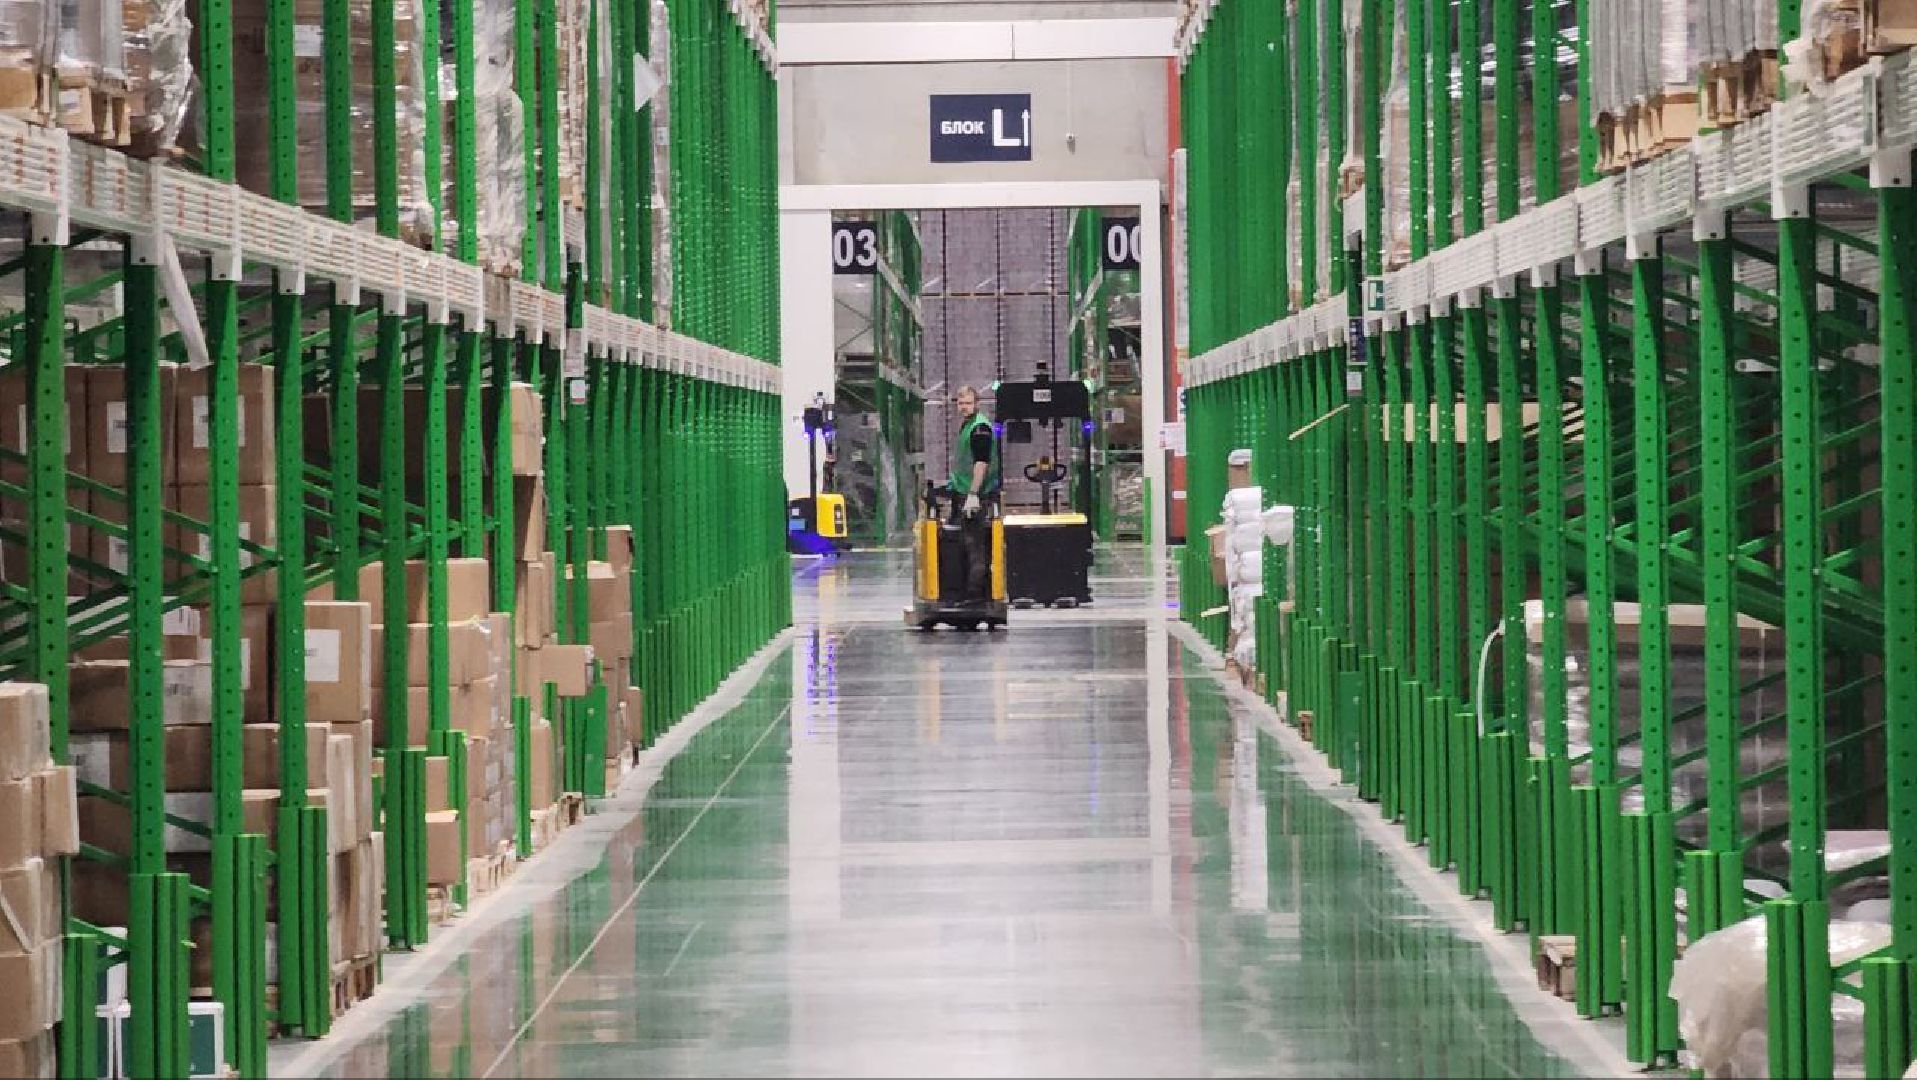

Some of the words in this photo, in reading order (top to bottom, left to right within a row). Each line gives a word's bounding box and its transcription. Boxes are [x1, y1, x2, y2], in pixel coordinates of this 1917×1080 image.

[941, 121, 984, 134] БЛОК
[992, 108, 1021, 147] L
[834, 229, 877, 266] 03
